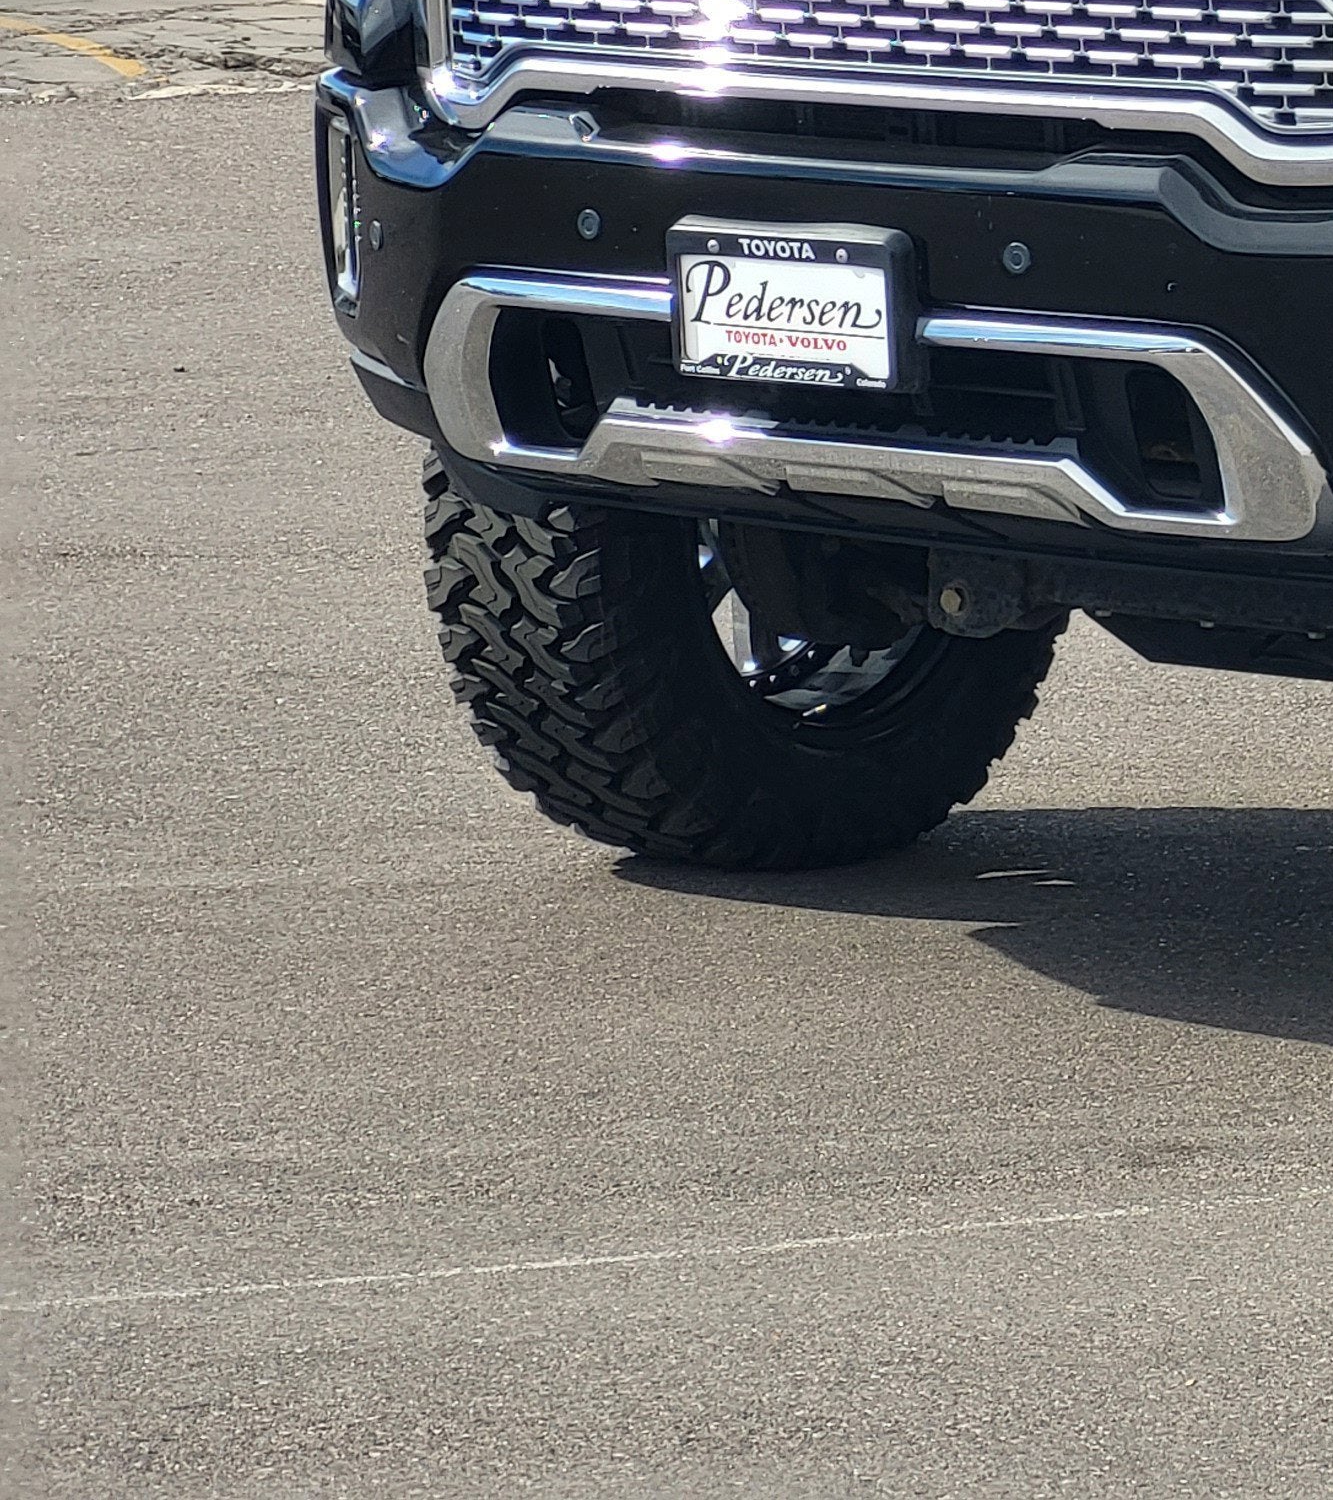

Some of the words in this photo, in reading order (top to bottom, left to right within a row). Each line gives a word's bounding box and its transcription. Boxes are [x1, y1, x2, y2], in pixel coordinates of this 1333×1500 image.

[738, 238, 816, 260] TOYOTA
[686, 260, 882, 329] Pedersen
[725, 330, 778, 347] TOYOTA
[786, 335, 848, 351] VOLVO
[724, 353, 844, 383] Pedersen
